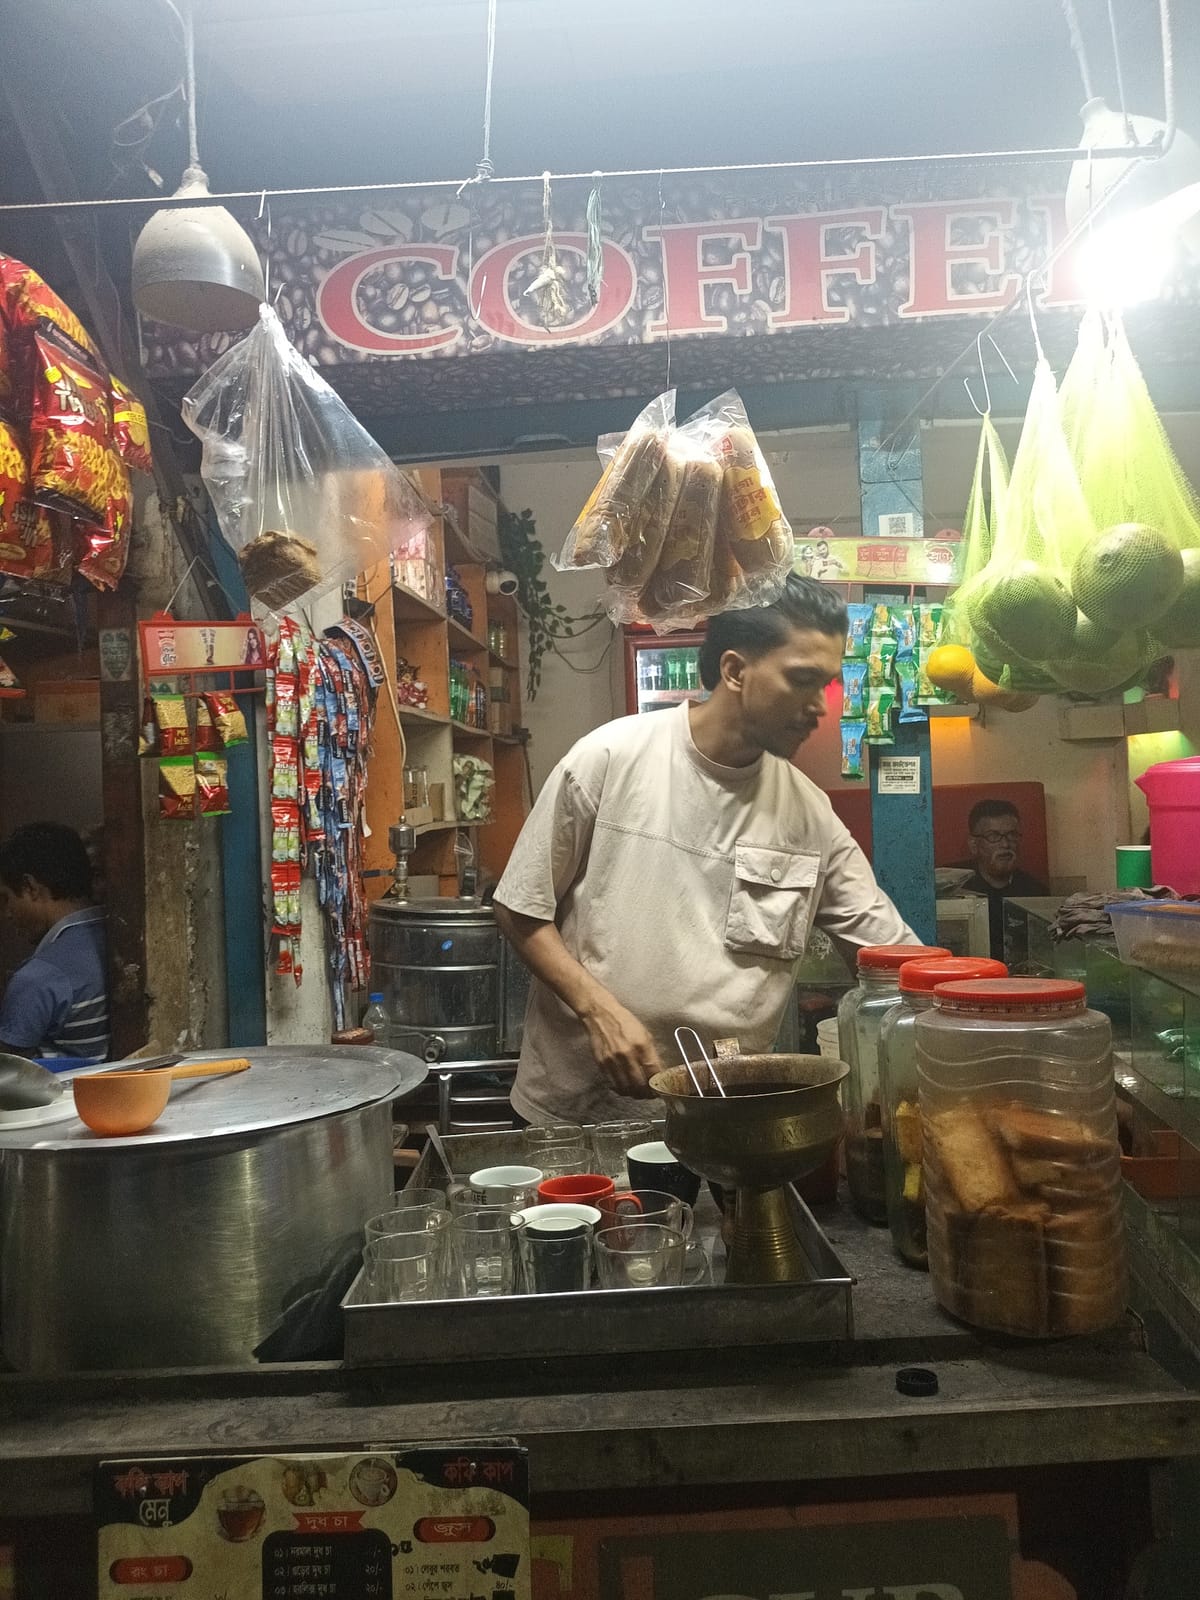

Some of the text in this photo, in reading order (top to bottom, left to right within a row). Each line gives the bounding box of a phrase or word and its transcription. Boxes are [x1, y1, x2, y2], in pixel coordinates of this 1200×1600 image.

[140, 1498, 173, 1528] মেনু
[305, 1515, 348, 1530] দুধ চা
[152, 1564, 169, 1577] চা
